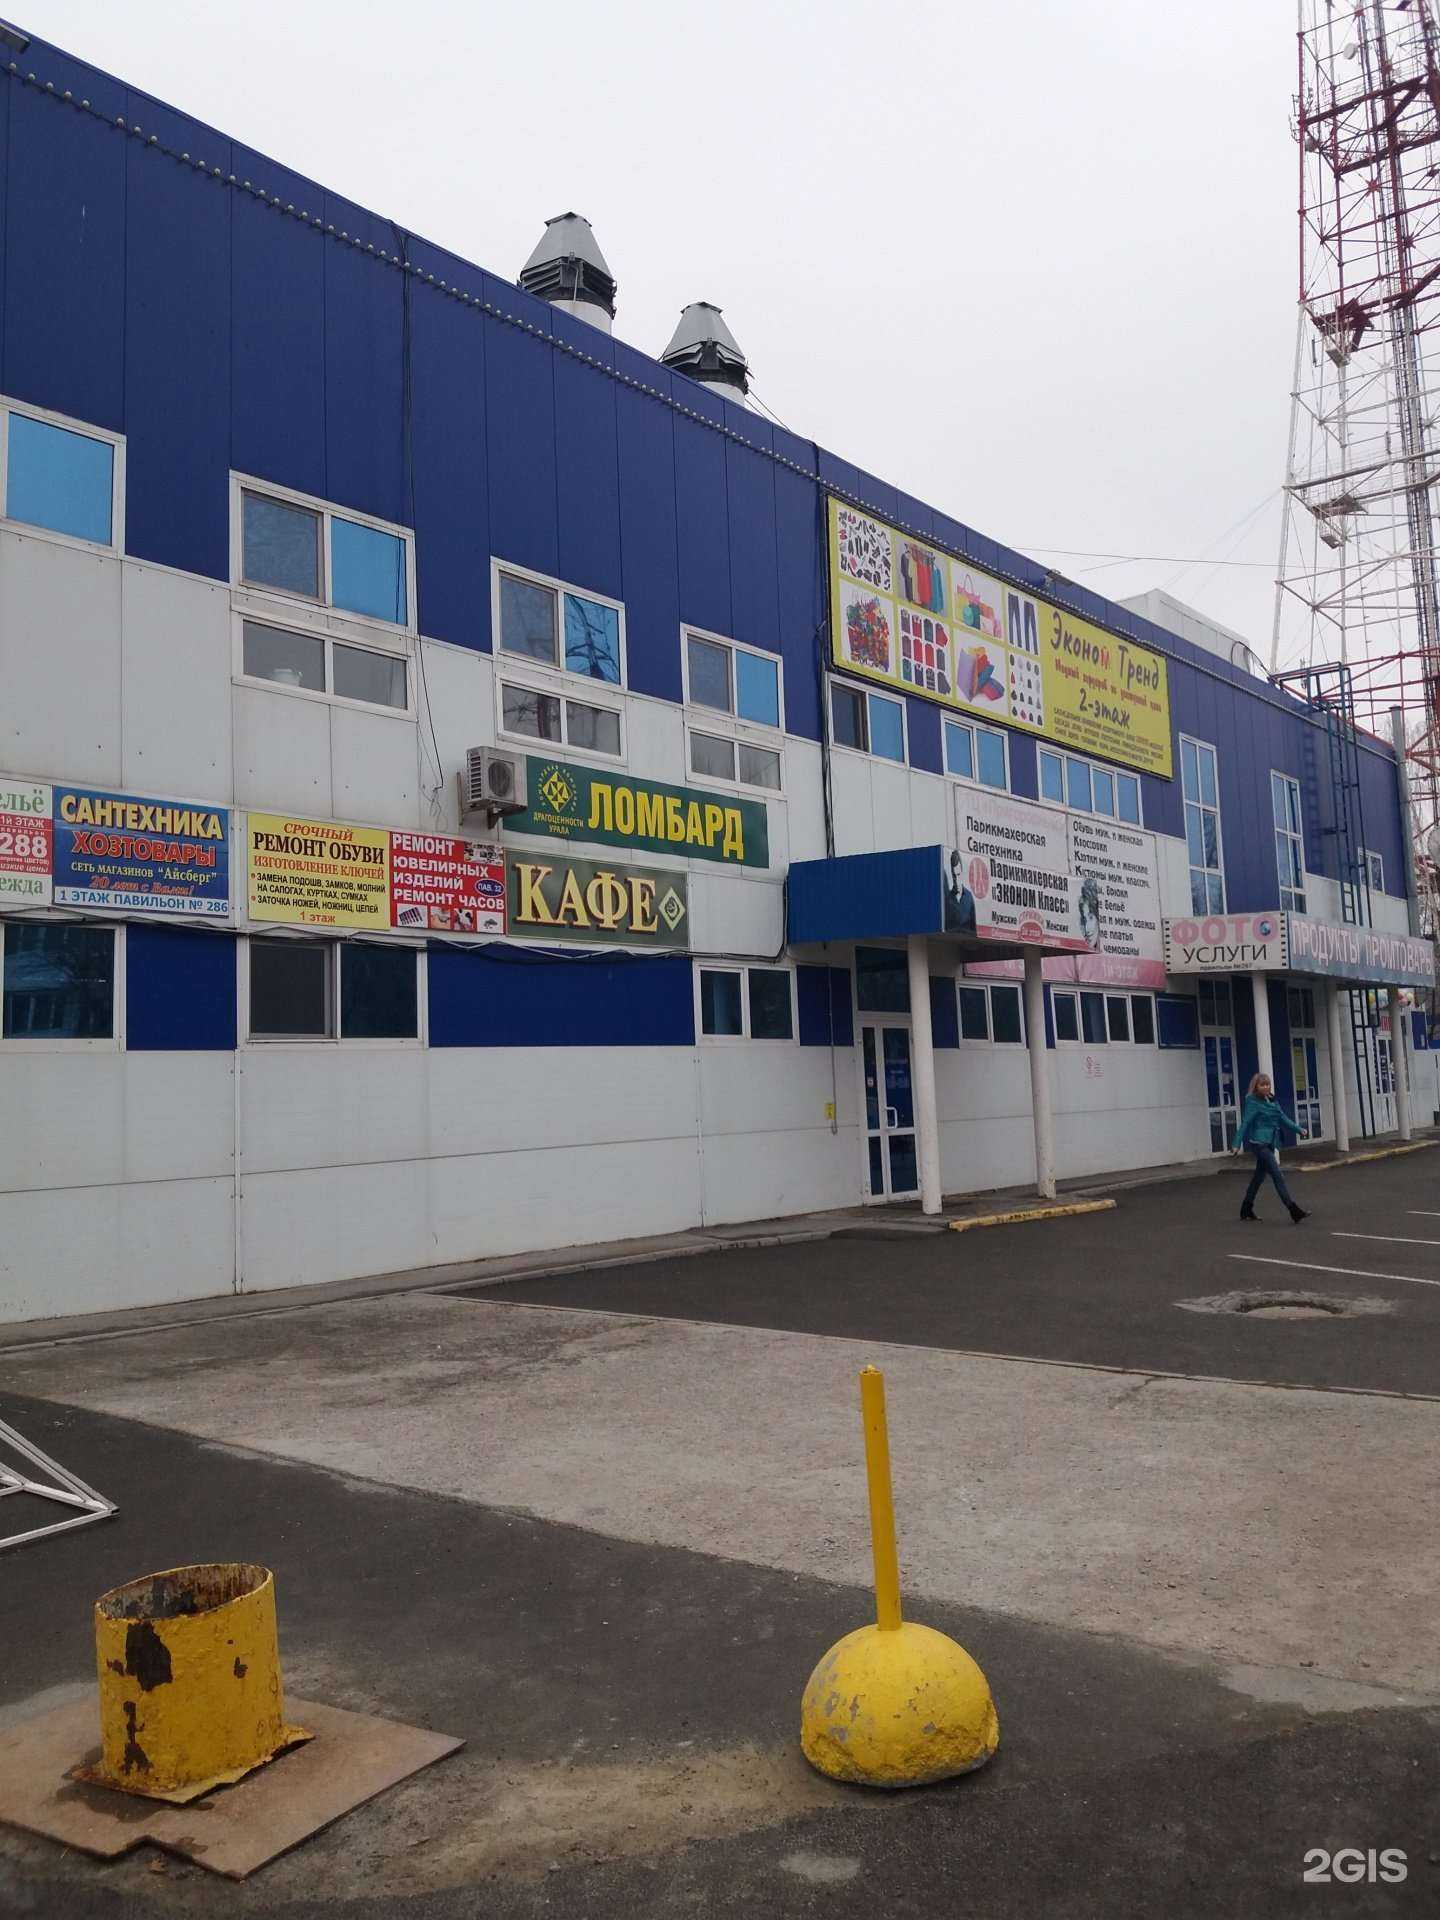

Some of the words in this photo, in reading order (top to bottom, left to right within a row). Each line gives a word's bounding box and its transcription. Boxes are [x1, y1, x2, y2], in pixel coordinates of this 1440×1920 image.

[1118, 644, 1159, 691] Тренд
[1079, 687, 1130, 730] 2-этаж
[0, 787, 44, 814] льё
[15, 817, 45, 829] ЭТАЖ
[60, 794, 224, 840] САНТЕХНИКА
[533, 811, 584, 828] ДРАГОЦЕННОСТИ
[587, 781, 745, 861] ЛОМБАРД
[1073, 820, 1093, 835] Обувь
[283, 822, 354, 841] СРОЧНЫЙ
[549, 825, 570, 835] УРАЛА
[966, 815, 1046, 847] Парикмахерская
[0, 832, 47, 858] 288
[71, 830, 216, 867] ХОЗТОВАРЫ
[252, 831, 326, 857] РЕМОНТ
[329, 842, 385, 865] ОБУВИ
[392, 833, 455, 857] РЕМОНТ
[967, 836, 1023, 861] Сантехника
[71, 861, 95, 873] СЕТЬ
[97, 864, 154, 878] МАГАЗИНОВ
[253, 855, 339, 875] ИЗГОТОВЛЕНИЕ
[341, 865, 385, 880] КЛЮЧЕЙ
[393, 855, 489, 878] ЮВЕЛИРНЫХ
[990, 859, 1069, 892] Парикмахерская
[88, 875, 110, 889] 20
[256, 872, 288, 884] ЗАМЕНА
[289, 876, 323, 888] ПОДОШВ,
[325, 879, 356, 892] ЗАМКОВ,
[357, 883, 386, 893] МОЛНИЙ
[257, 883, 267, 892] НА
[269, 885, 305, 897] САПОГАХ,
[306, 889, 340, 900] КУРТКАХ,
[341, 892, 368, 902] СУМКАХ
[393, 871, 464, 891] ИЗДЕЛИЙ
[60, 890, 67, 901] 1
[71, 890, 110, 903] ЭТАЖ
[114, 893, 185, 909] ПАВИЛЬОН
[189, 899, 203, 910] №
[207, 901, 228, 913] 286
[257, 895, 290, 906] ЗАТОЧКА
[292, 897, 320, 910] НОЖЕЙ,
[355, 903, 379, 914] ЦЕПЕЙ
[393, 888, 455, 905] РЕМОНТ
[458, 894, 505, 910] ЧАСОВ
[513, 862, 660, 935] КАФЕ
[299, 911, 306, 921] 1
[309, 914, 336, 923] этаж
[991, 911, 1018, 925] Мужские
[1045, 919, 1069, 933] Женские
[1172, 915, 1279, 945] ФОТО
[1183, 943, 1268, 965] УСЛУГИ
[1290, 919, 1361, 966] ПРОДУКТЫ
[1364, 933, 1434, 976] ПРОМТОВАРЫ
